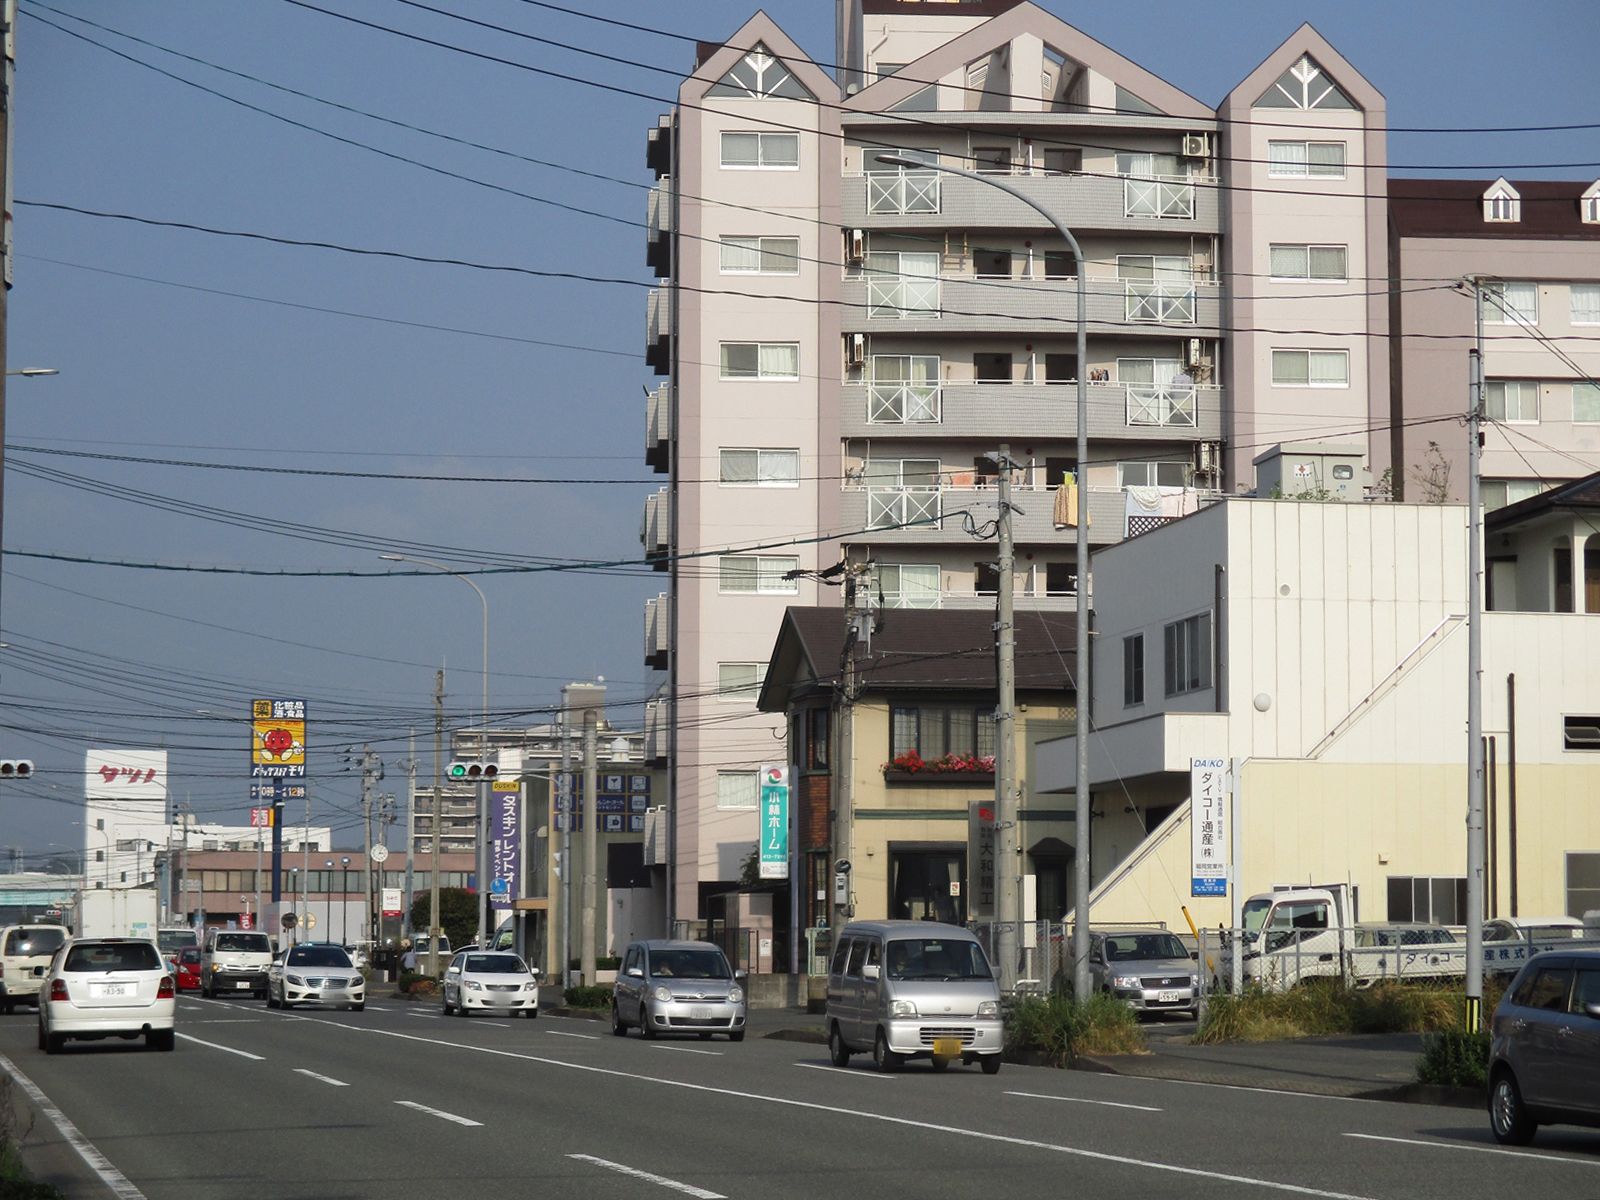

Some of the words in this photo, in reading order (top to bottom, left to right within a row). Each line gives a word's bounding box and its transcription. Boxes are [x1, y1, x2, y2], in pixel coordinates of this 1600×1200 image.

[274, 701, 304, 710] 化粧品
[1193, 759, 1224, 768] DAIKO
[99, 765, 157, 784] タツノ
[252, 809, 270, 827] 酒
